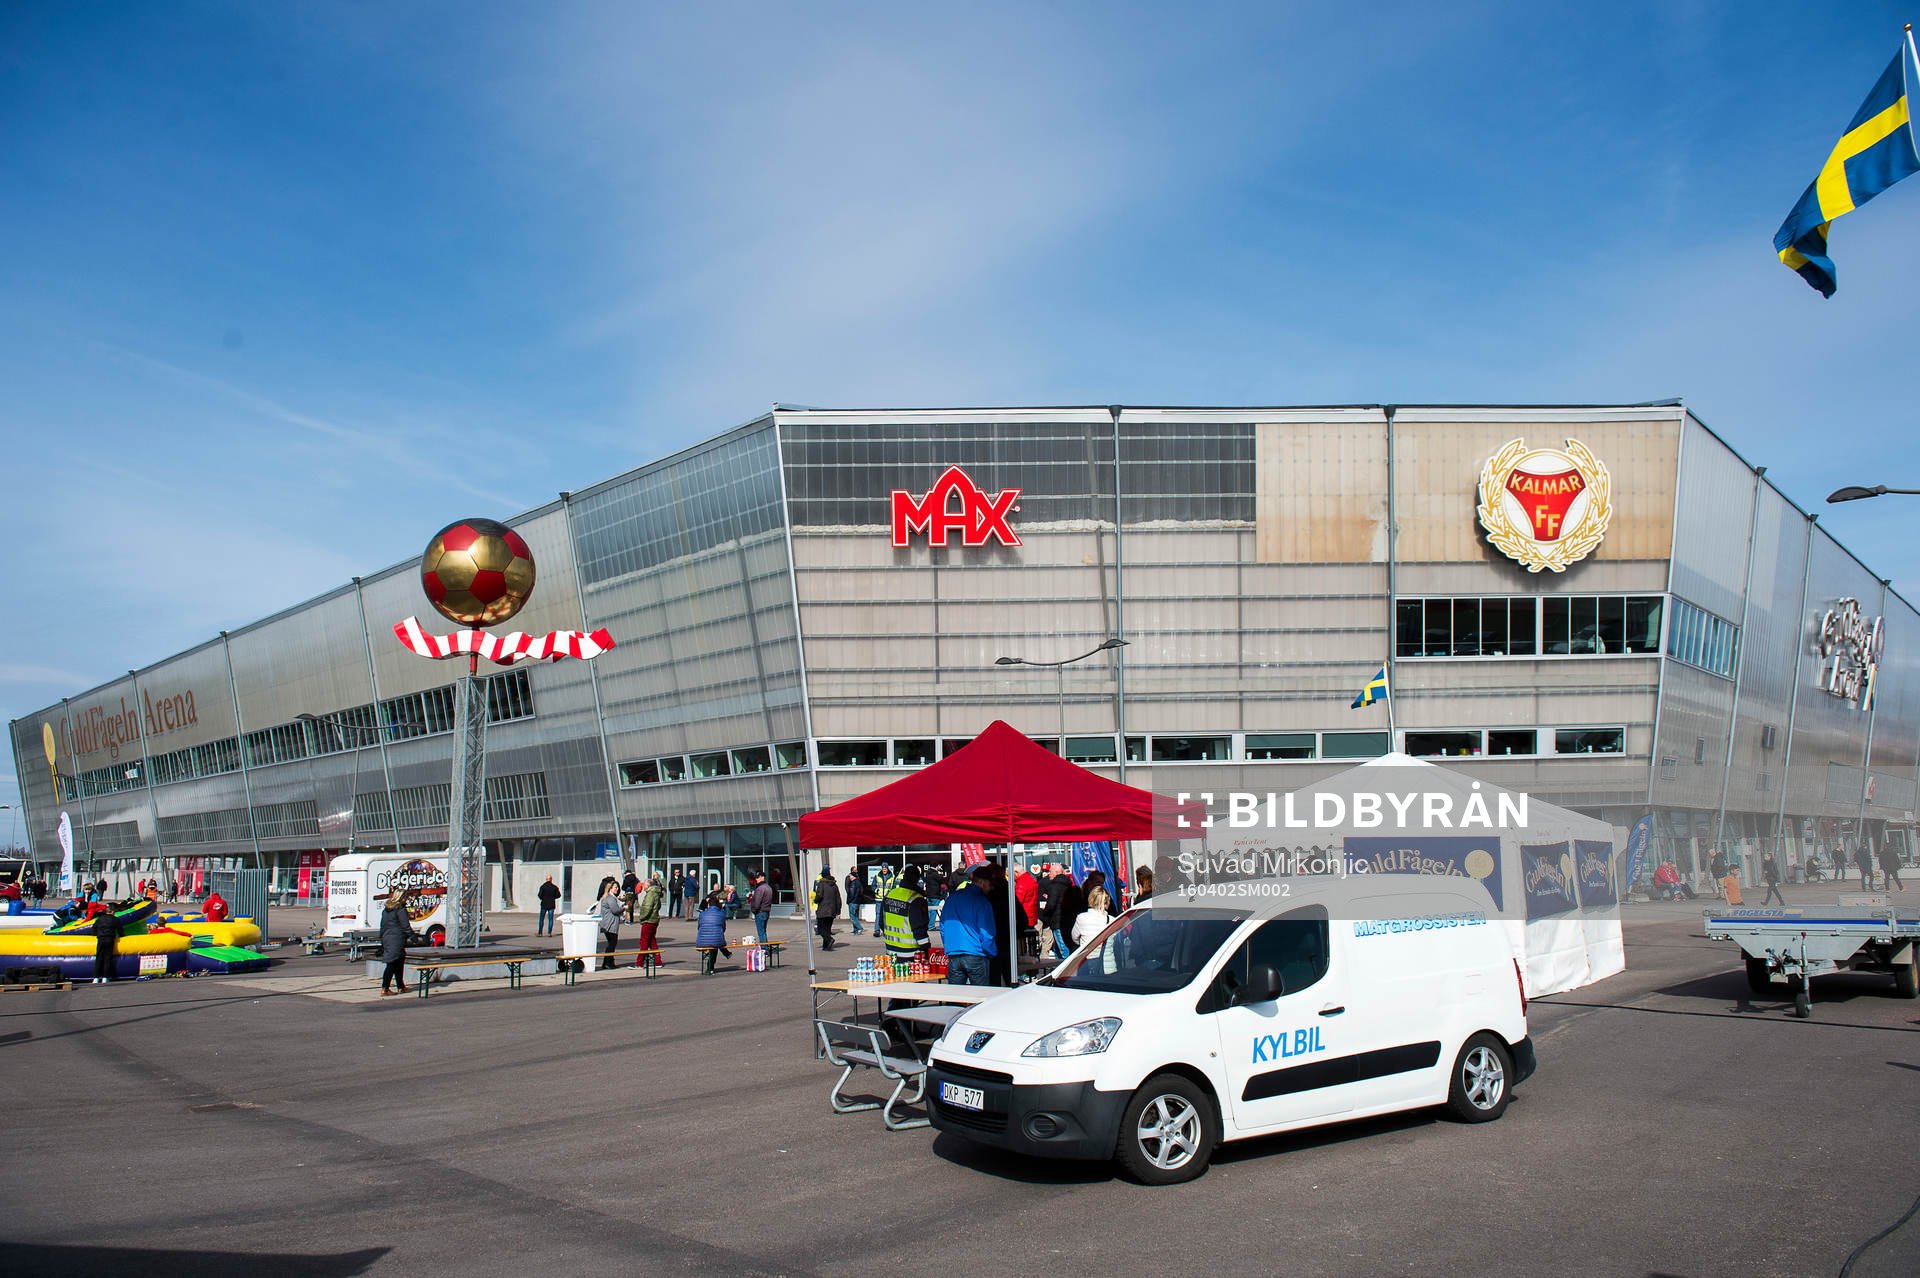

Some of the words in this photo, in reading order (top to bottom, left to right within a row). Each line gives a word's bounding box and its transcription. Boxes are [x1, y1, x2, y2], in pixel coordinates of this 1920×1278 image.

[1509, 473, 1583, 495] KALMAR
[890, 464, 1024, 547] MAX
[1535, 505, 1560, 537] FF
[143, 688, 198, 737] Arena
[1353, 911, 1487, 937] MATGROSSISTEN
[1252, 1026, 1326, 1064] KYLBIL
[944, 1084, 959, 1101] DKP
[964, 1089, 982, 1107] 577
